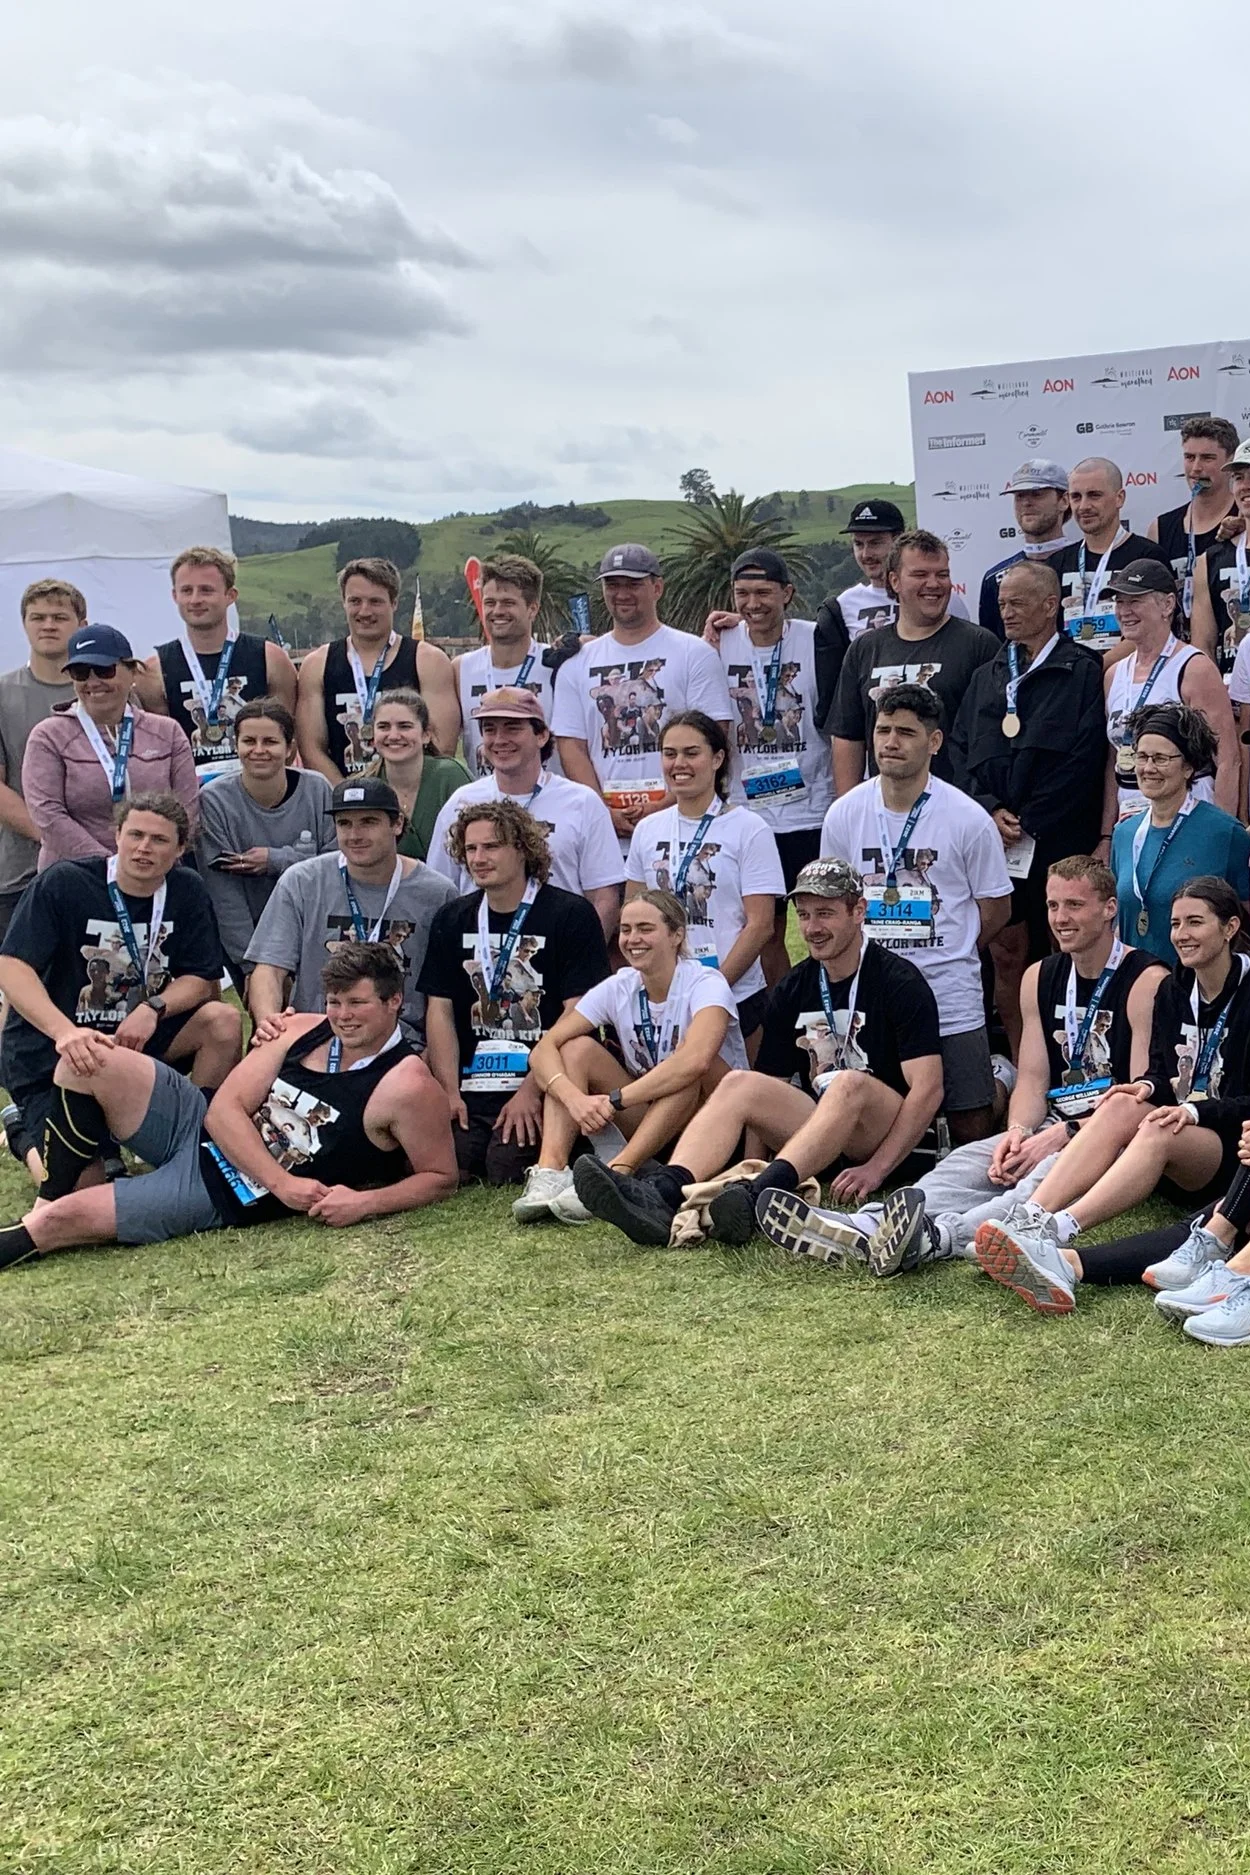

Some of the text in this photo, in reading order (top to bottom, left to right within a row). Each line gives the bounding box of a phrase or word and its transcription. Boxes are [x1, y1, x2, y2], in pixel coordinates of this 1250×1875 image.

[1167, 366, 1200, 382] AON
[1042, 378, 1074, 394] AON
[924, 390, 954, 405] AON
[1076, 422, 1094, 434] GB
[944, 434, 985, 448] Informer
[1125, 472, 1157, 487] AON
[999, 528, 1016, 538] GB
[1075, 618, 1106, 634] 359
[737, 743, 778, 754] TAYLOR
[755, 774, 787, 792] 3162
[618, 792, 650, 806] 1128
[878, 903, 912, 917] 3114
[913, 936, 944, 948] KITE
[76, 1009, 127, 1023] TAYLOR
[476, 1055, 509, 1071] 3011
